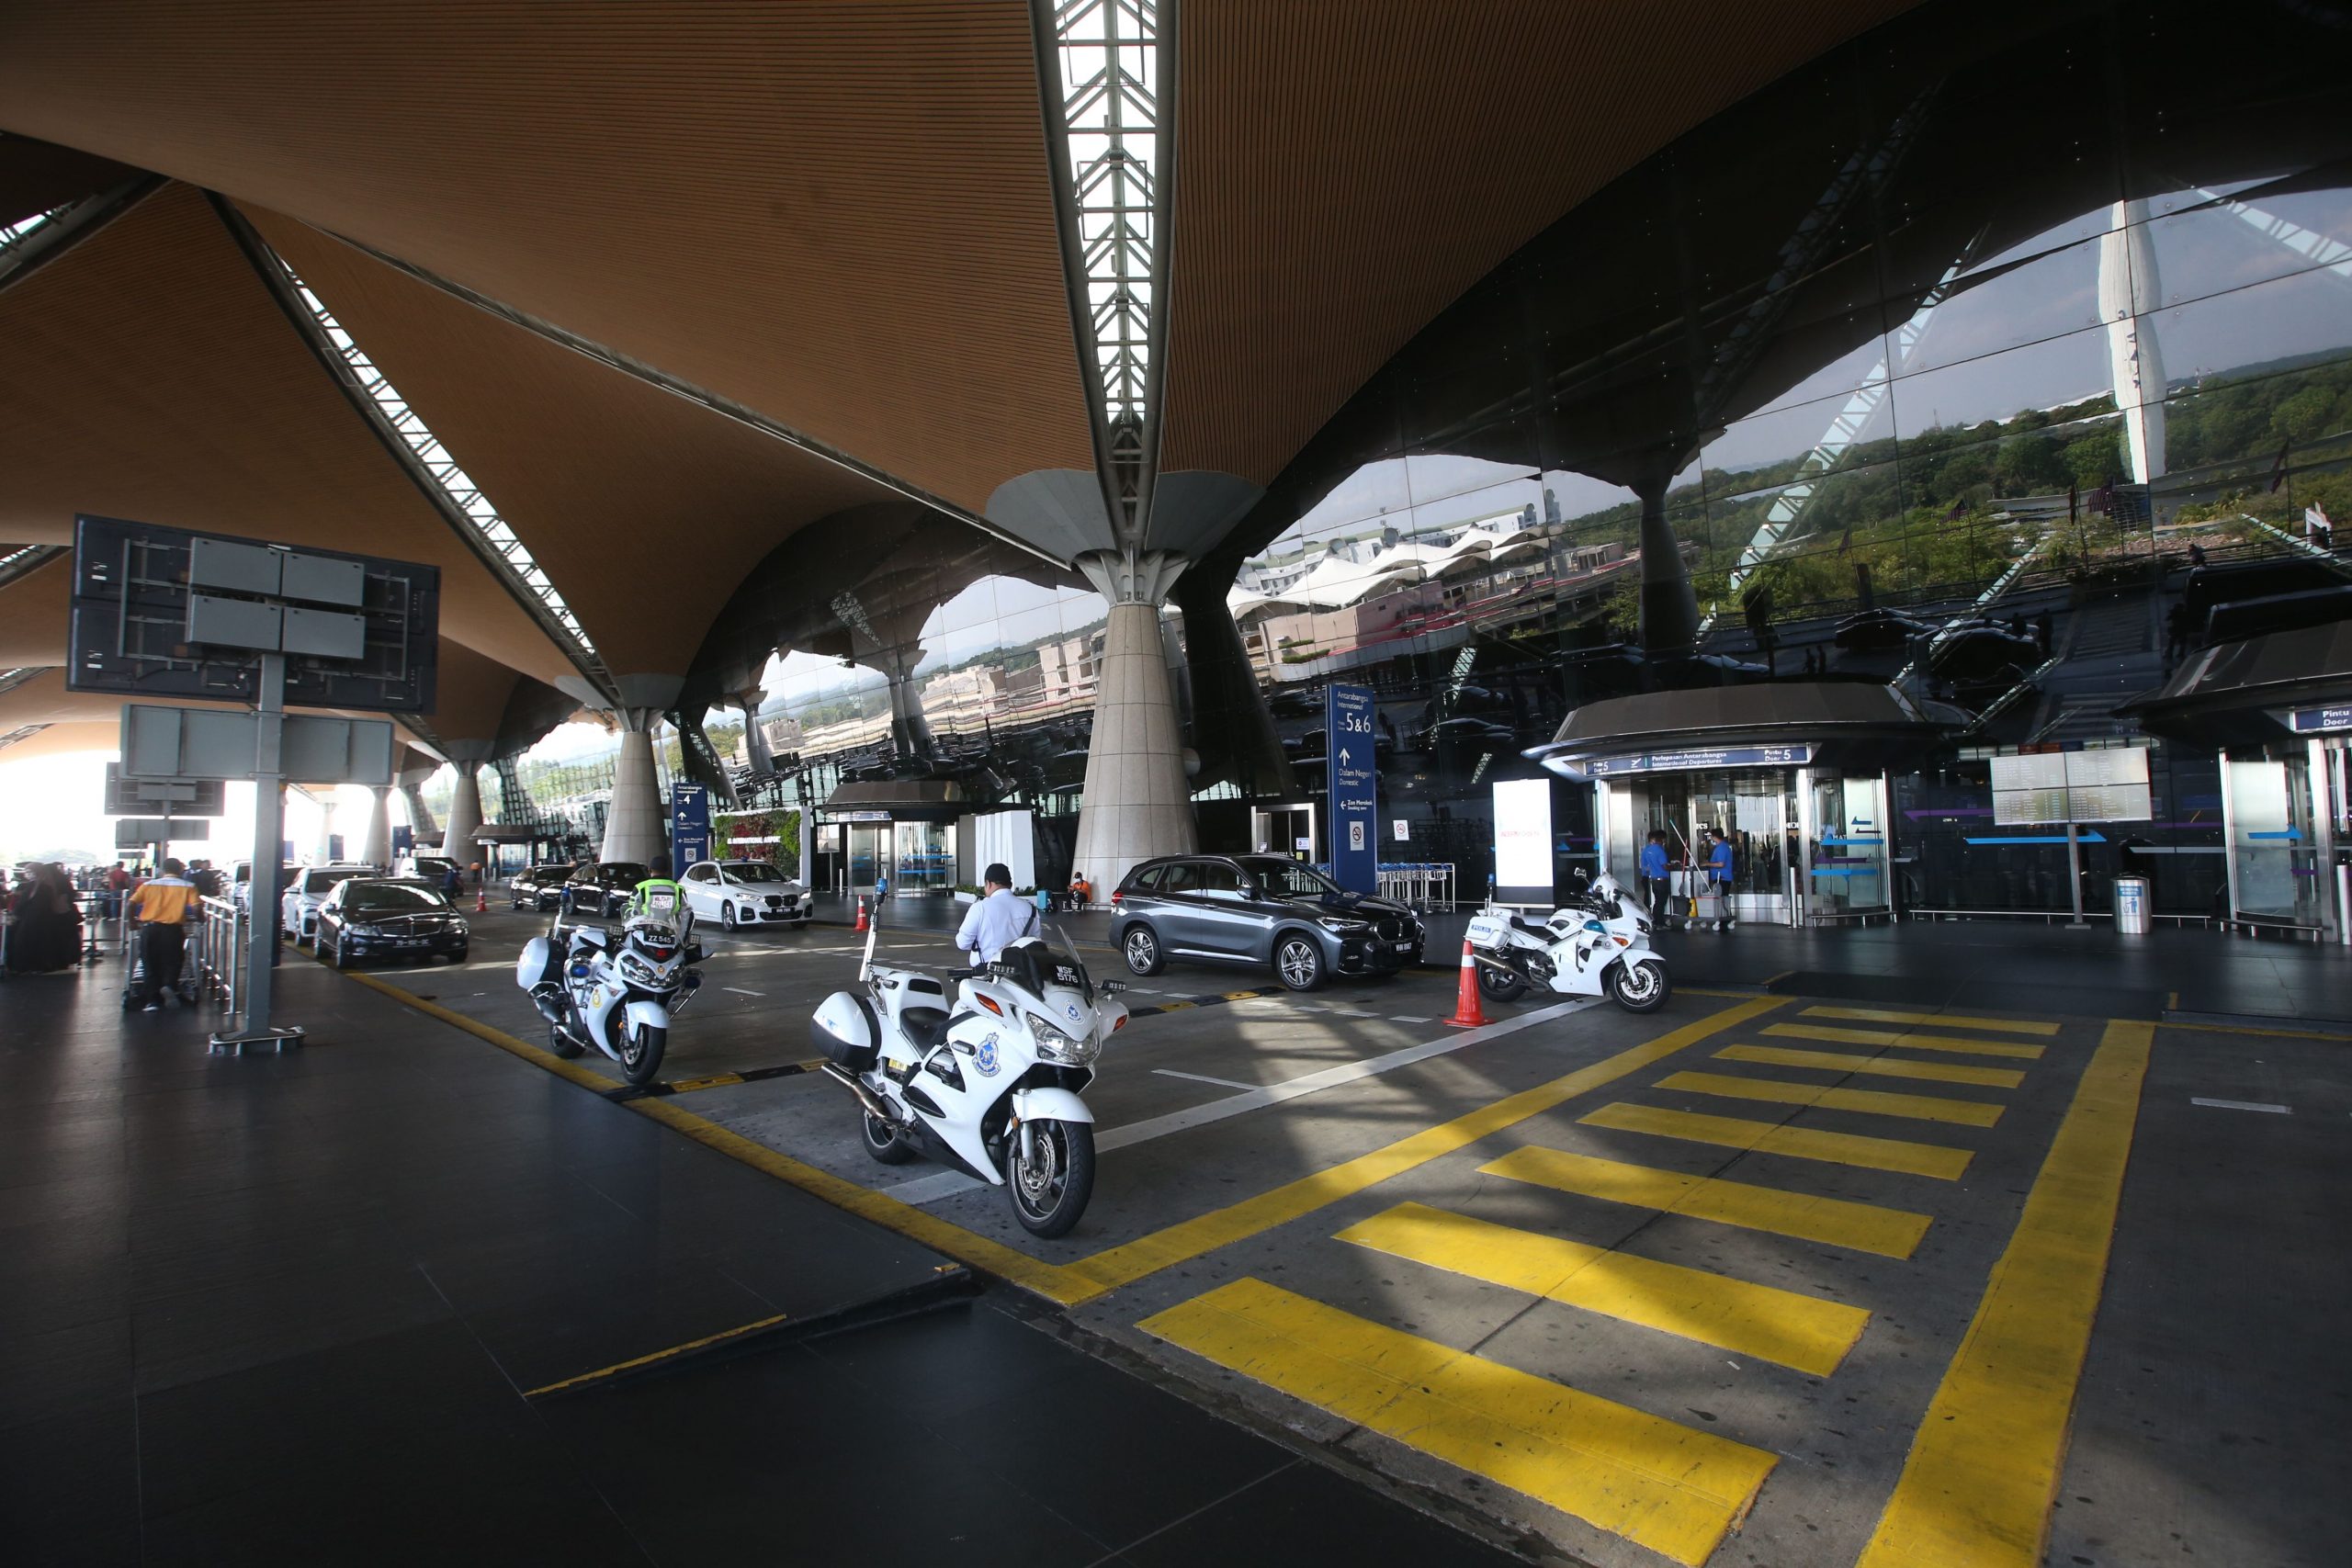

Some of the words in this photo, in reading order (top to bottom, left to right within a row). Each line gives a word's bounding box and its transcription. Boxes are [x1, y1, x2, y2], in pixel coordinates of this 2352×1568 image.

[1346, 712, 1353, 732] 5
[1354, 718, 1363, 732] &
[1363, 715, 1371, 733] 6
[1783, 750, 1792, 761] 5
[1603, 761, 1609, 772] 5
[1339, 768, 1355, 777] Dalam
[1339, 778, 1359, 786] Domestic
[684, 794, 691, 805] 4
[1057, 965, 1073, 975] WSF
[1057, 973, 1079, 983] 5176
